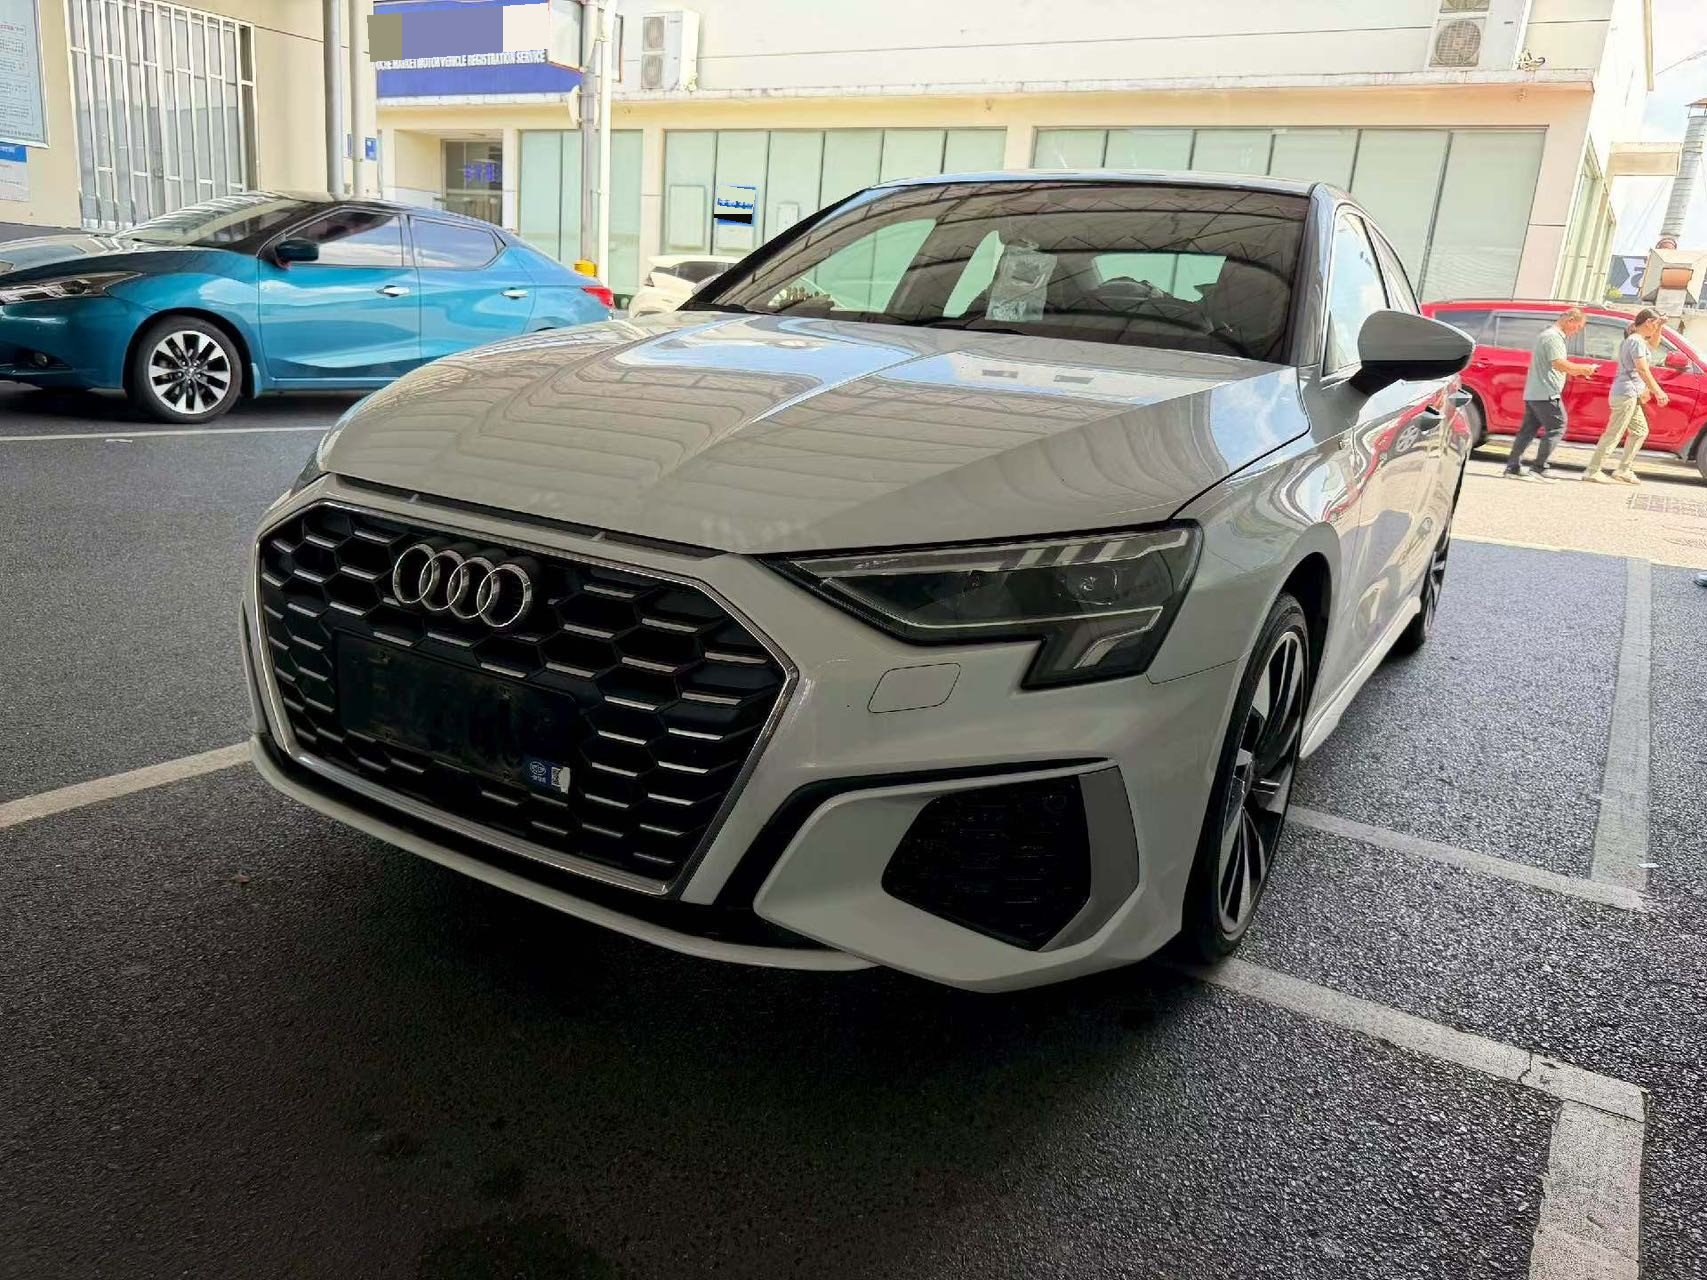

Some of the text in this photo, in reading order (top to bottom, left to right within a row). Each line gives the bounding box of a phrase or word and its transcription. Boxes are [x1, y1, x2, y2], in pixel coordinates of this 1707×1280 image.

[441, 55, 467, 67] VEHICLE
[467, 51, 516, 66] REGISTRATION
[516, 50, 546, 64] SERVICE
